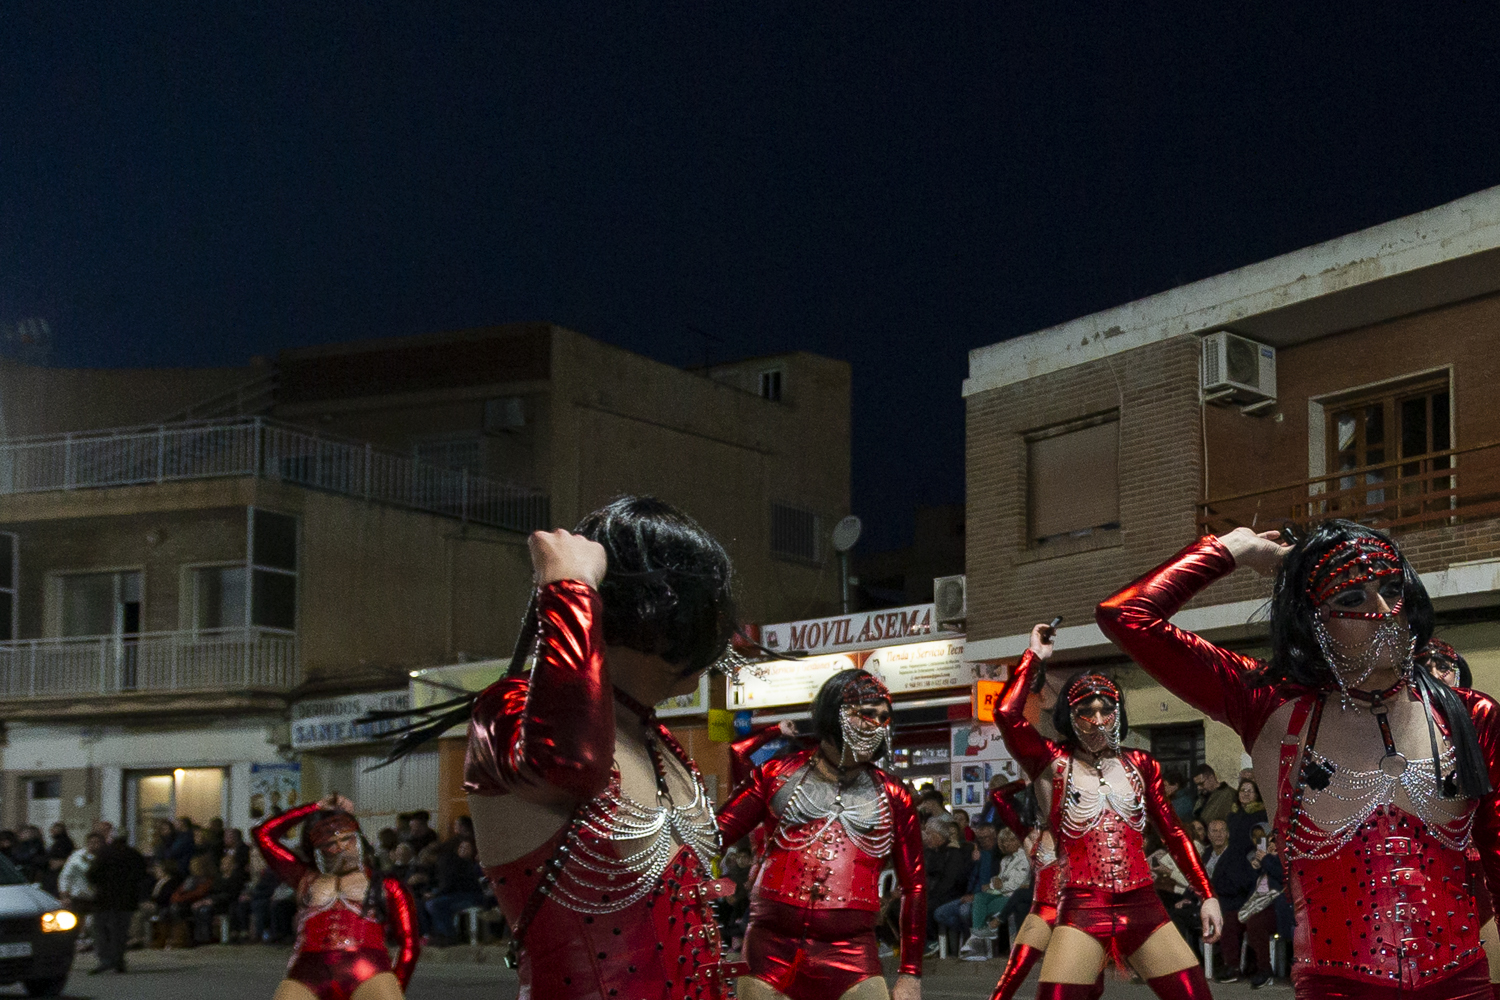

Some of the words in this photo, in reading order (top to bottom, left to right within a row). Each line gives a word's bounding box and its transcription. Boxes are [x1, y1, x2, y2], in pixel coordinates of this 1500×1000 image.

[788, 618, 853, 651] MOVIL
[856, 608, 931, 643] ASEMA
[886, 649, 909, 662] Tienda
[916, 645, 945, 660] Servicio
